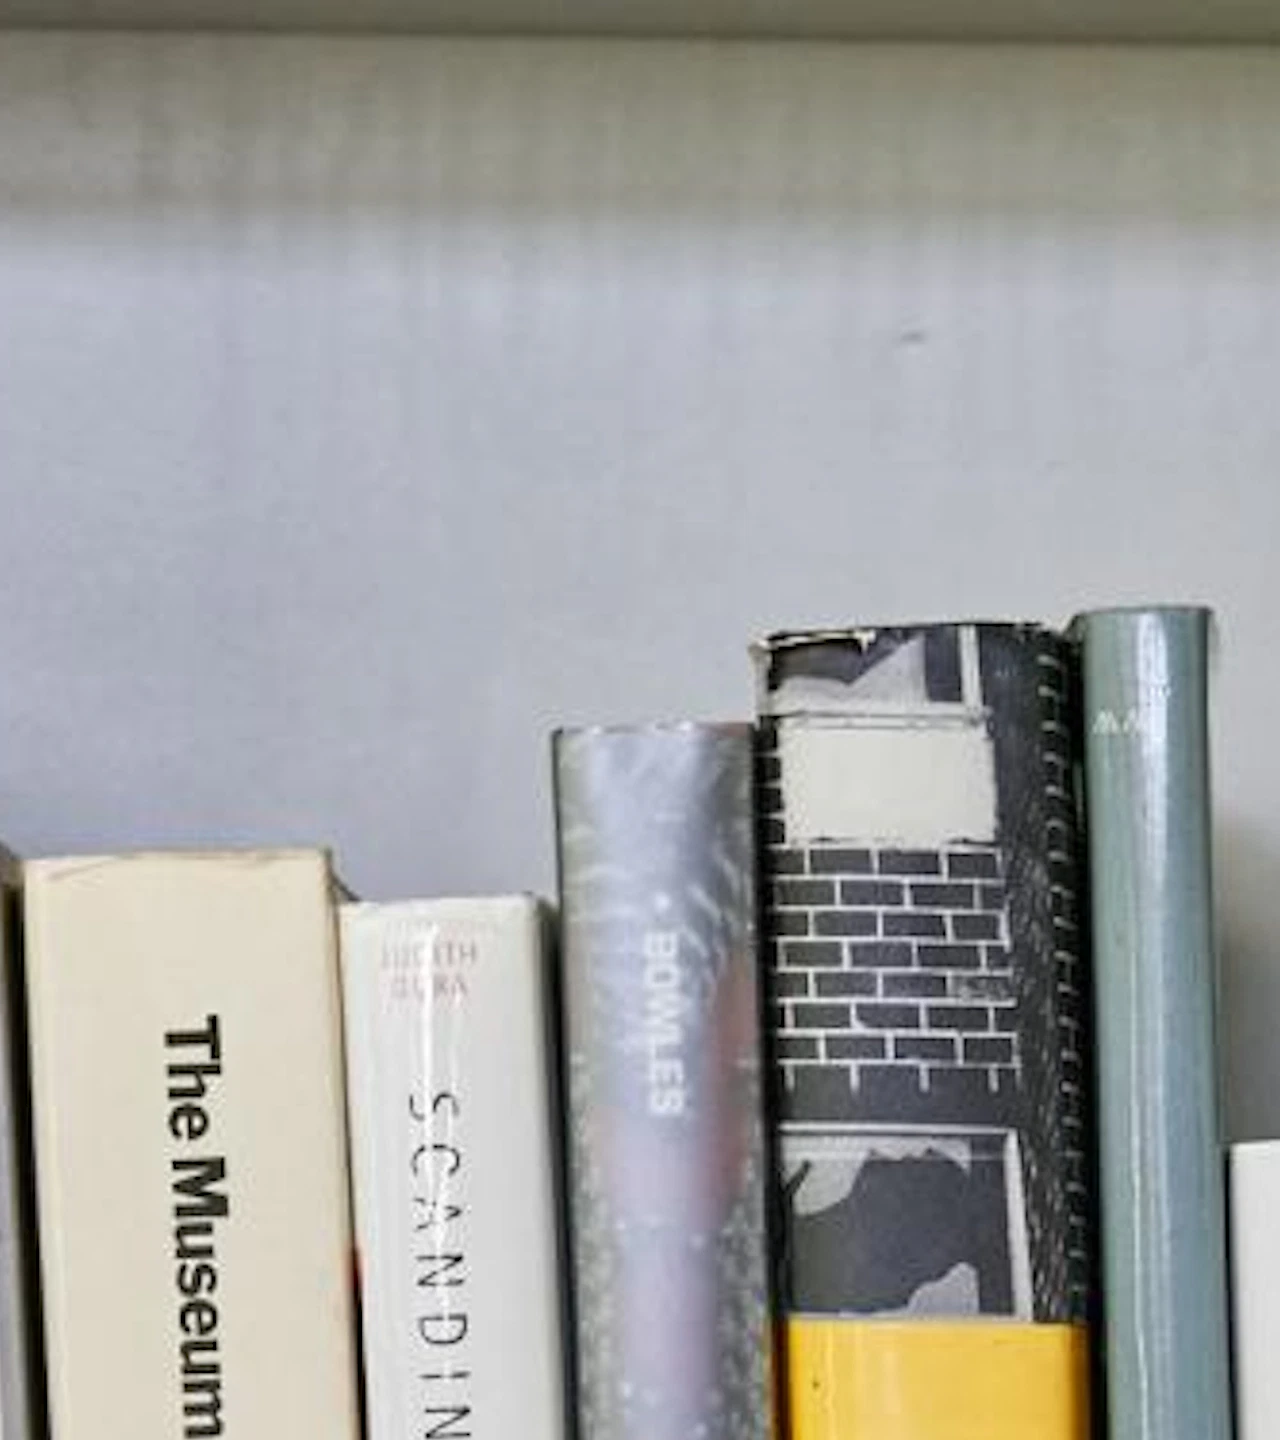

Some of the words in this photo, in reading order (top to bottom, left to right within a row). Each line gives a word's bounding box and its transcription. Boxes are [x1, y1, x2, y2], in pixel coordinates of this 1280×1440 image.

[163, 1014, 221, 1143] The
[645, 930, 685, 1117] BOWLES
[170, 1155, 230, 1440] Museum
